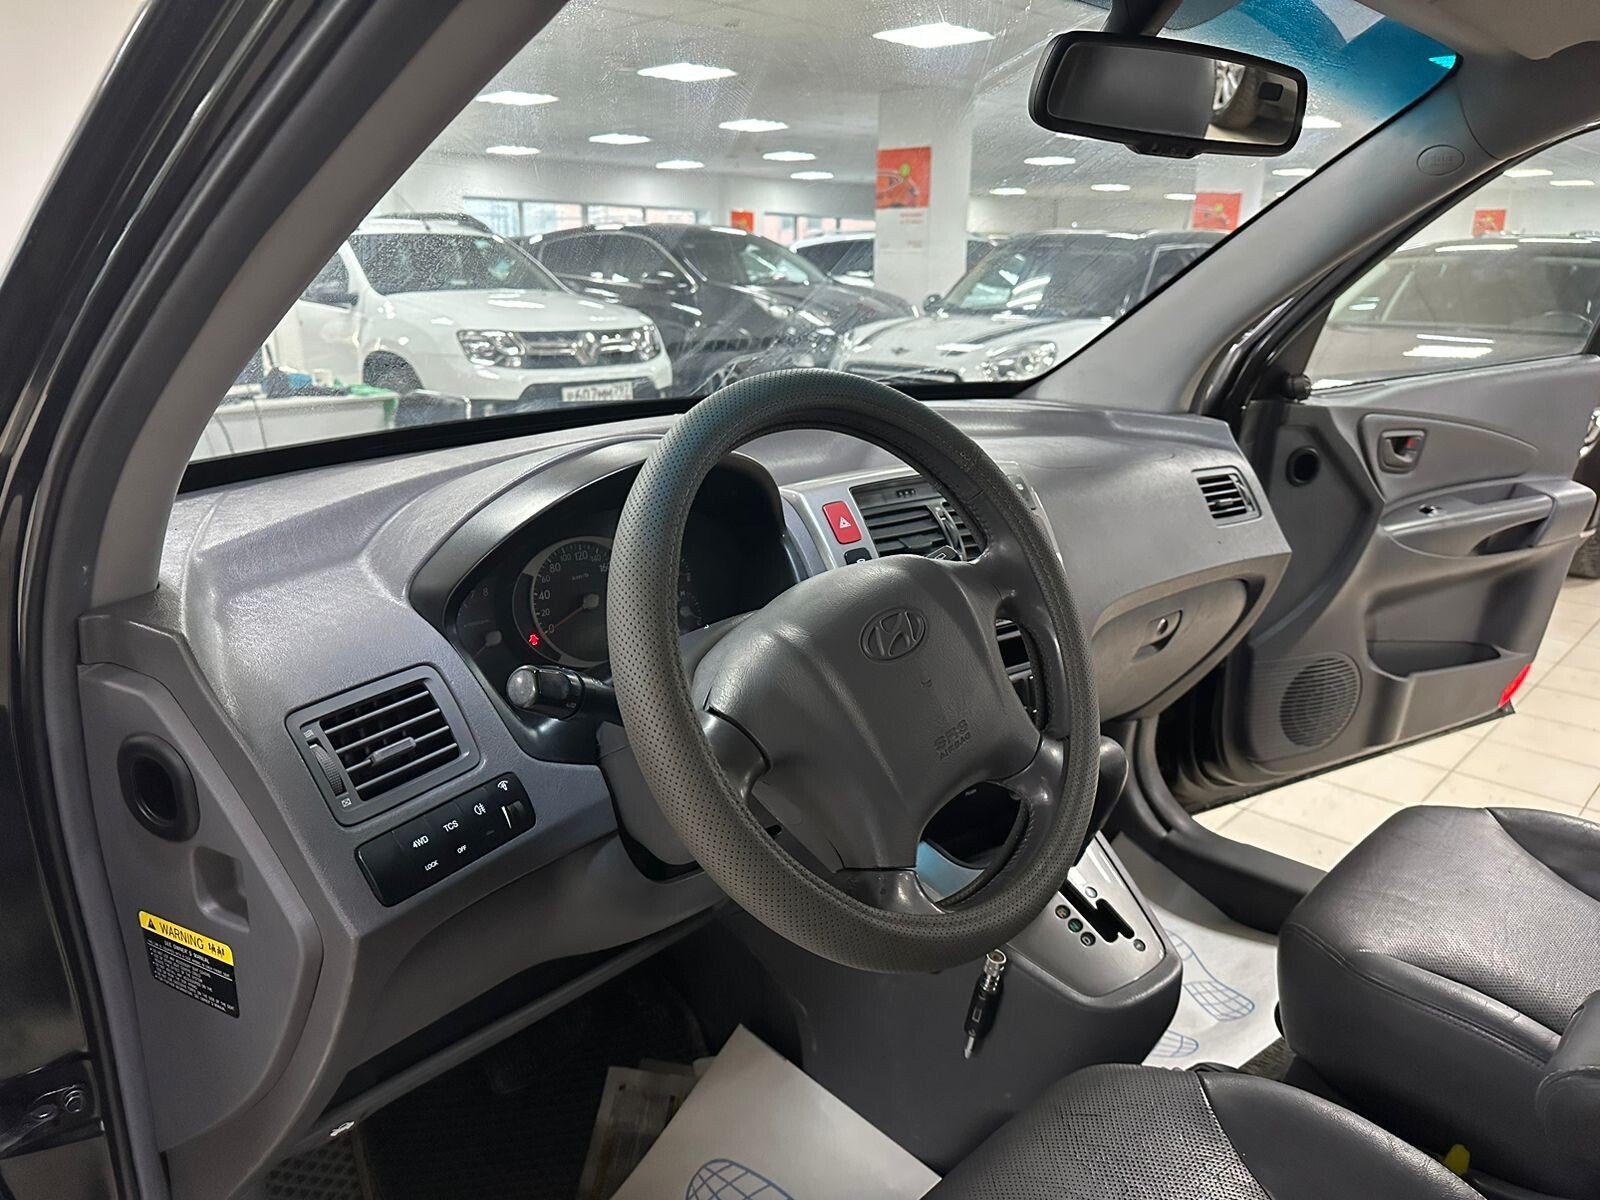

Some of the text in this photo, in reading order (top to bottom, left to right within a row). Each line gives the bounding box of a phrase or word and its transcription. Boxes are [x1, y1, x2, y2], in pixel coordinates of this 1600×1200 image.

[560, 554, 572, 562] 100
[574, 550, 588, 561] 120
[590, 554, 602, 562] 140
[549, 562, 562, 573] 80
[541, 575, 551, 583] 60
[482, 587, 489, 597] 8
[538, 590, 551, 601] 40
[541, 608, 551, 617] 20
[547, 624, 556, 634] 0
[443, 820, 459, 832] TCS
[412, 835, 429, 849] 4WD
[457, 844, 467, 854] OFF
[424, 859, 439, 871] LOCK
[160, 922, 204, 949] WARNING
